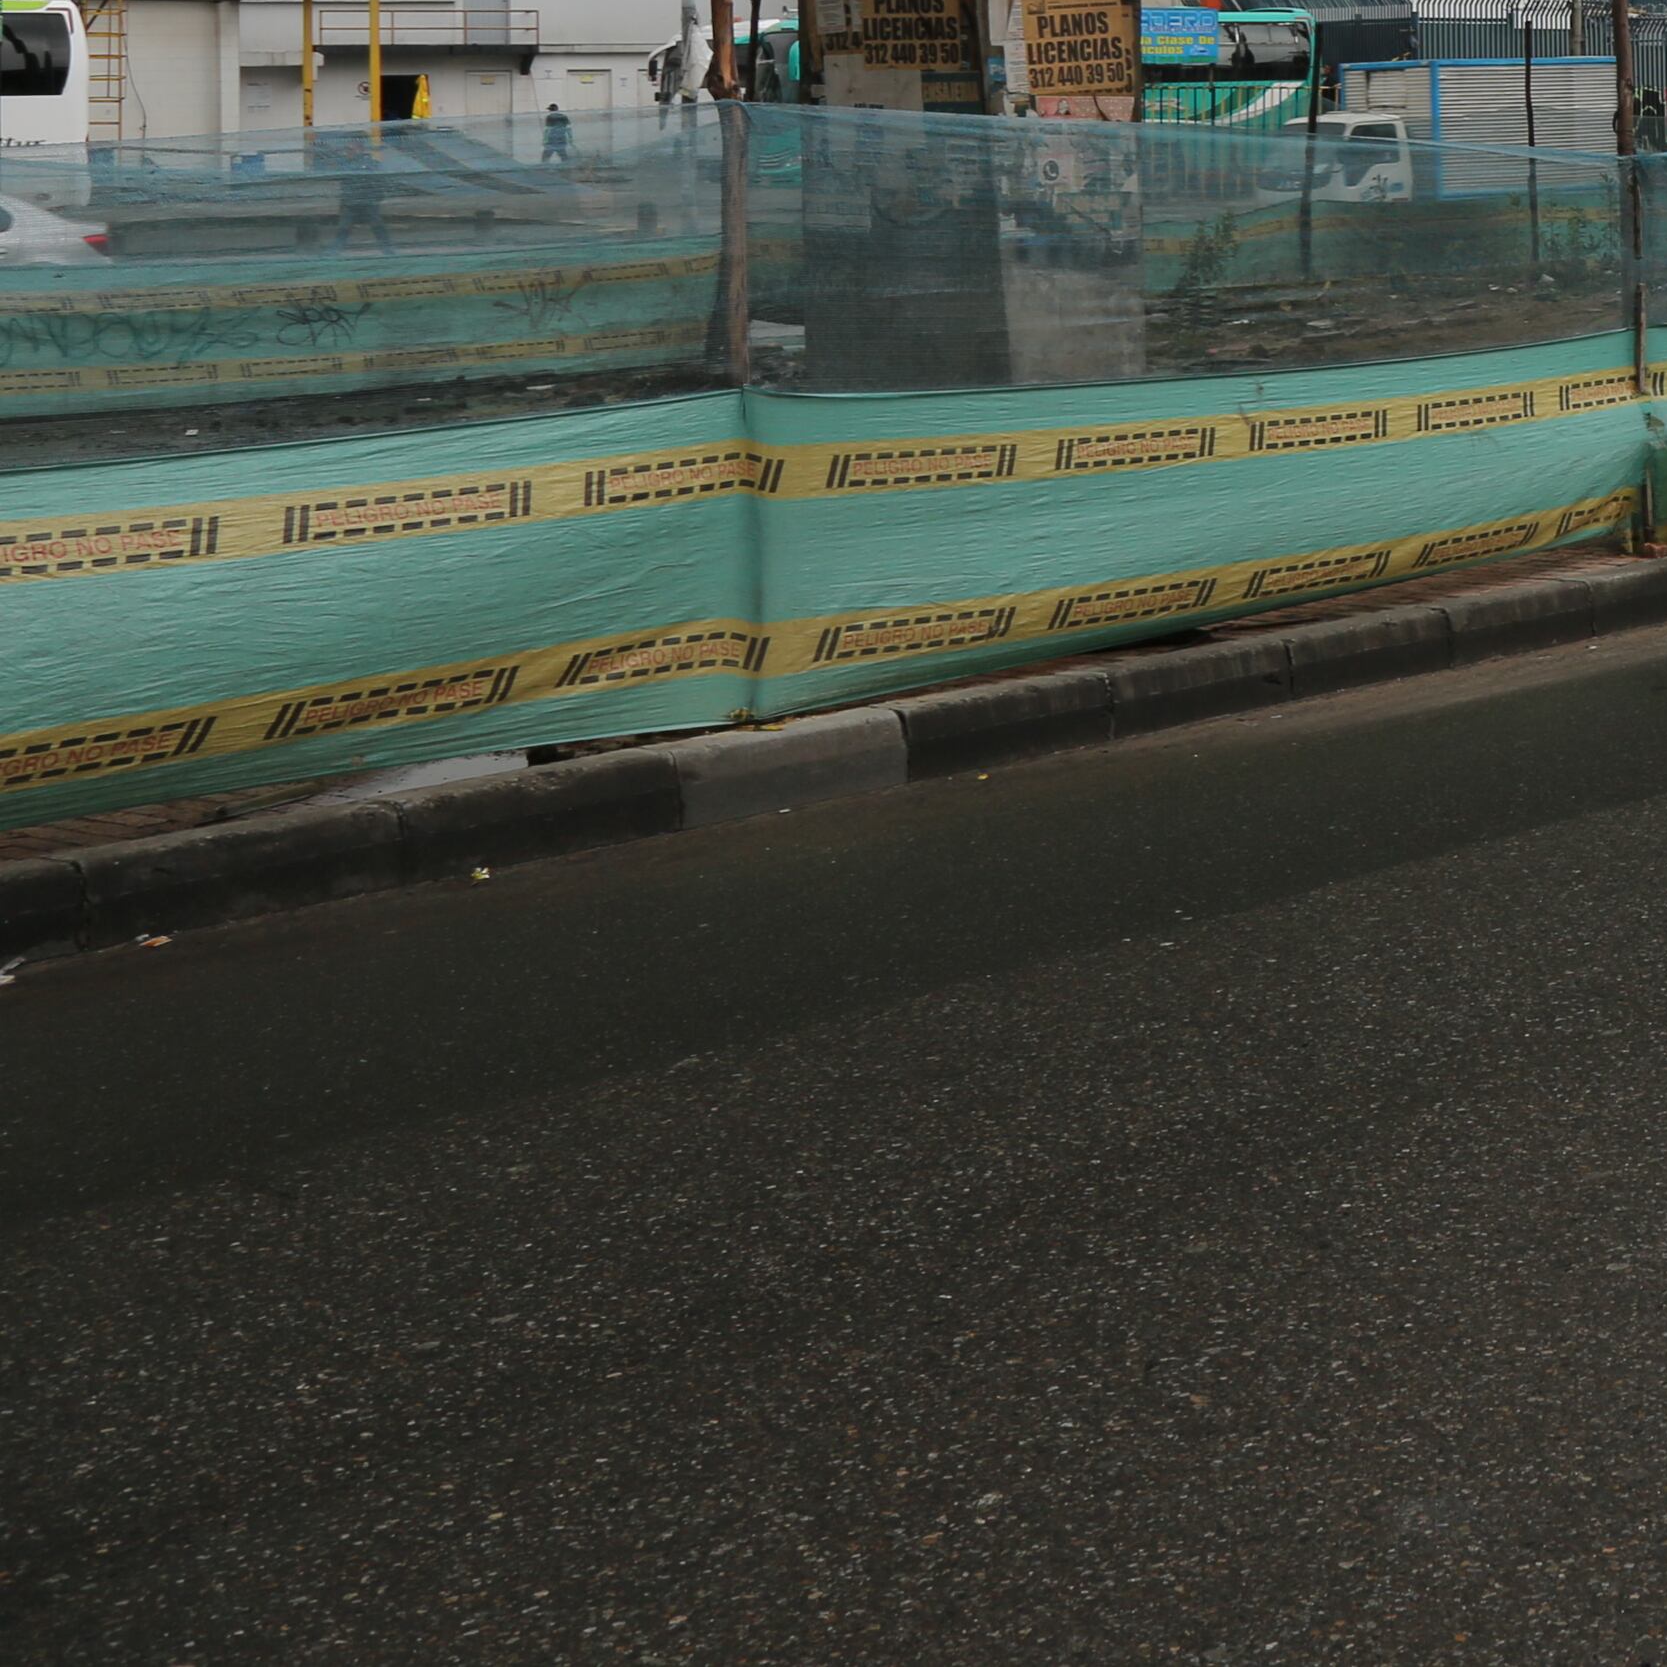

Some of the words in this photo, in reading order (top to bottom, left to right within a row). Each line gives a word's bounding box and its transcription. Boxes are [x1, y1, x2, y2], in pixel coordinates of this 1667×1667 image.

[862, 16, 958, 42] LICENCIAS
[1036, 11, 1109, 39] PLANOS
[864, 43, 889, 65] 312
[890, 43, 917, 65] 440
[919, 42, 938, 65] 39
[940, 42, 960, 64] 50
[1026, 36, 1123, 66] LICENCIAS
[1028, 67, 1055, 89] 312
[1057, 65, 1084, 86] 440
[1086, 63, 1105, 84] 39
[1106, 61, 1125, 83] 50
[608, 469, 683, 492] PELIGRO
[689, 465, 713, 481] NO
[717, 460, 757, 479] PASE
[315, 499, 409, 528] PELIGRO
[415, 498, 447, 517] NO
[450, 492, 504, 513] PASE
[76, 538, 113, 557] NO
[119, 528, 183, 552] PASE
[587, 647, 666, 674] PELIGRO
[671, 645, 695, 663] NO
[700, 640, 741, 659] PASE
[433, 681, 485, 702] PASE
[66, 745, 102, 764] NO
[108, 731, 174, 758] PASE
